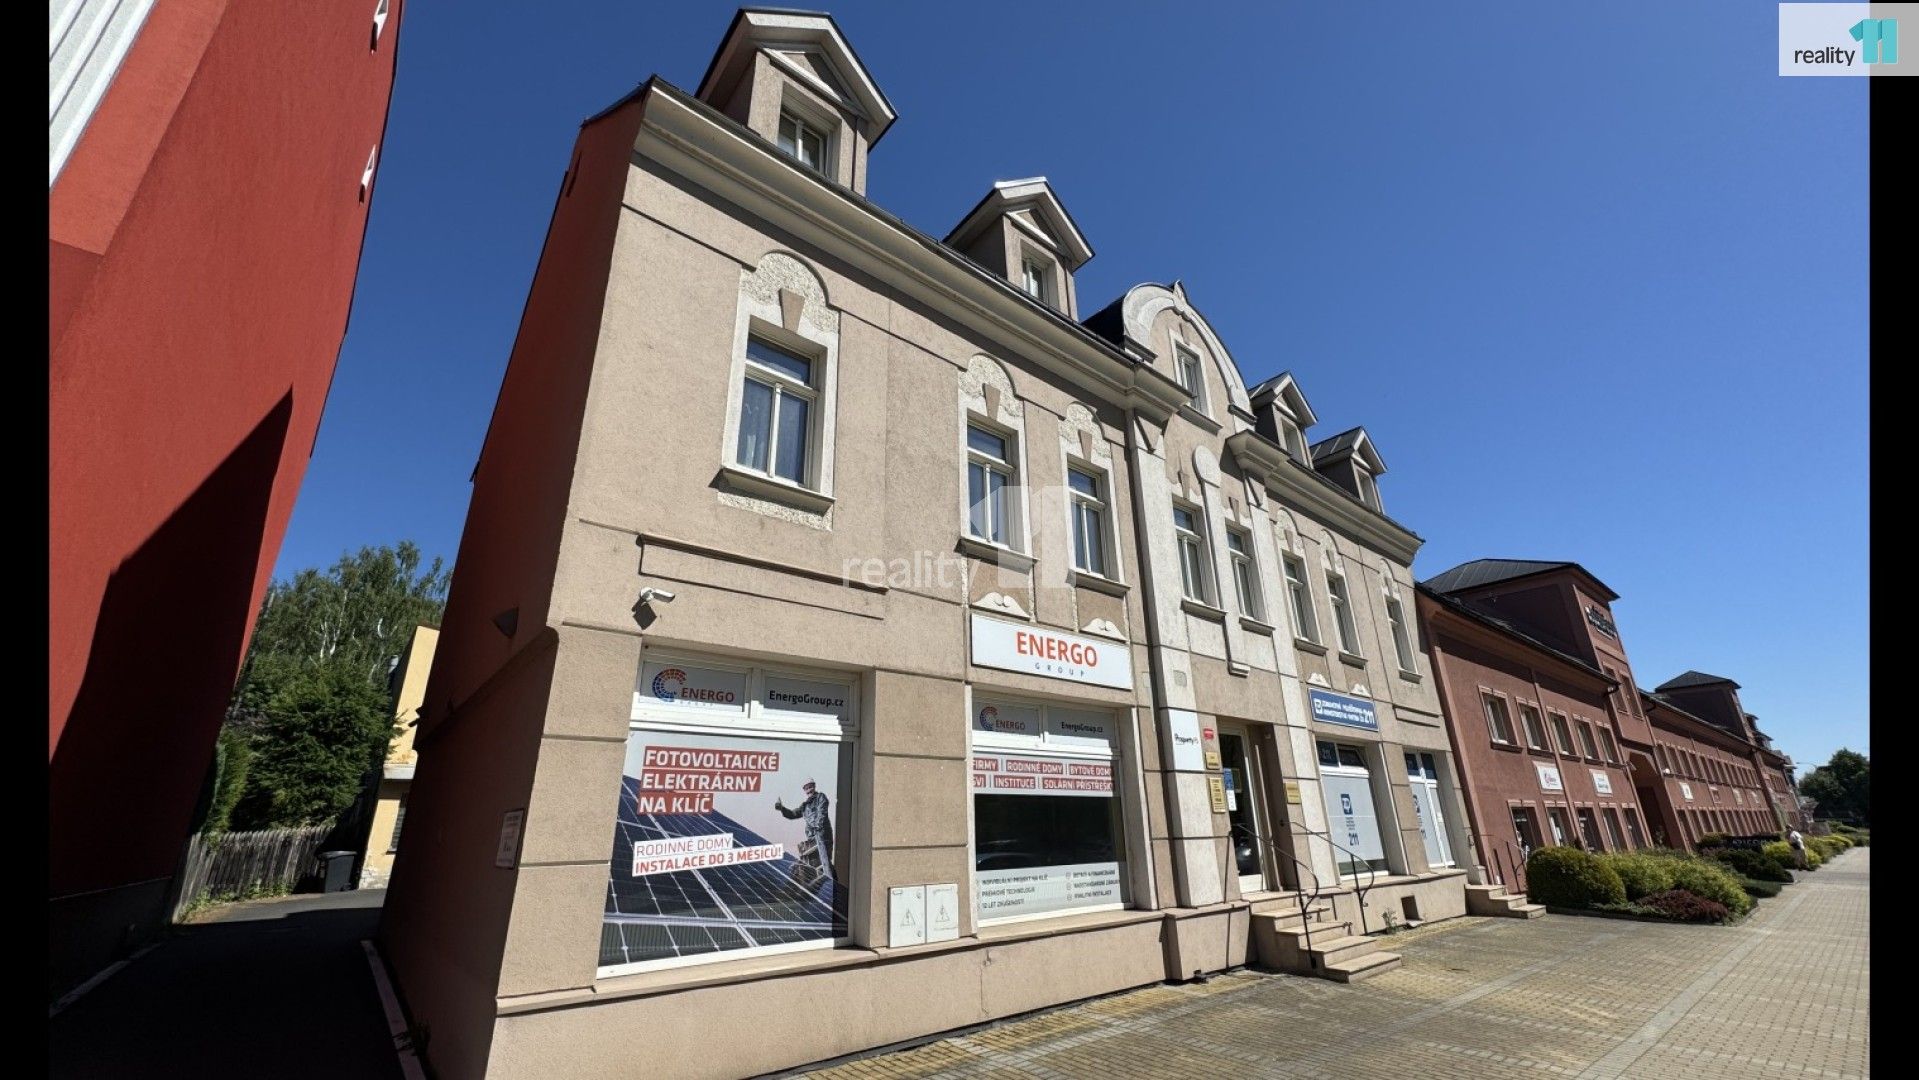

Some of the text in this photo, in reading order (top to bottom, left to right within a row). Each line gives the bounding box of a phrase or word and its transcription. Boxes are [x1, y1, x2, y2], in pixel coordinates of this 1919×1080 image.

[1016, 631, 1098, 668] ENERGO
[681, 687, 735, 703] ENERGO
[769, 690, 845, 707] EnergoGroup.cz
[995, 720, 1026, 731] ENERGO
[644, 749, 777, 770] FOTOVOLTAICKÉ
[1042, 763, 1063, 774] DOMY
[641, 772, 758, 790] ELEKTRÁRNY
[995, 776, 1035, 788] INSTITUCE
[639, 793, 711, 813] NA KLÍČ
[636, 837, 732, 857] RODINNÉ DOMY
[635, 855, 705, 874] INSTALACE
[708, 854, 725, 866] DO
[727, 853, 734, 863] 3
